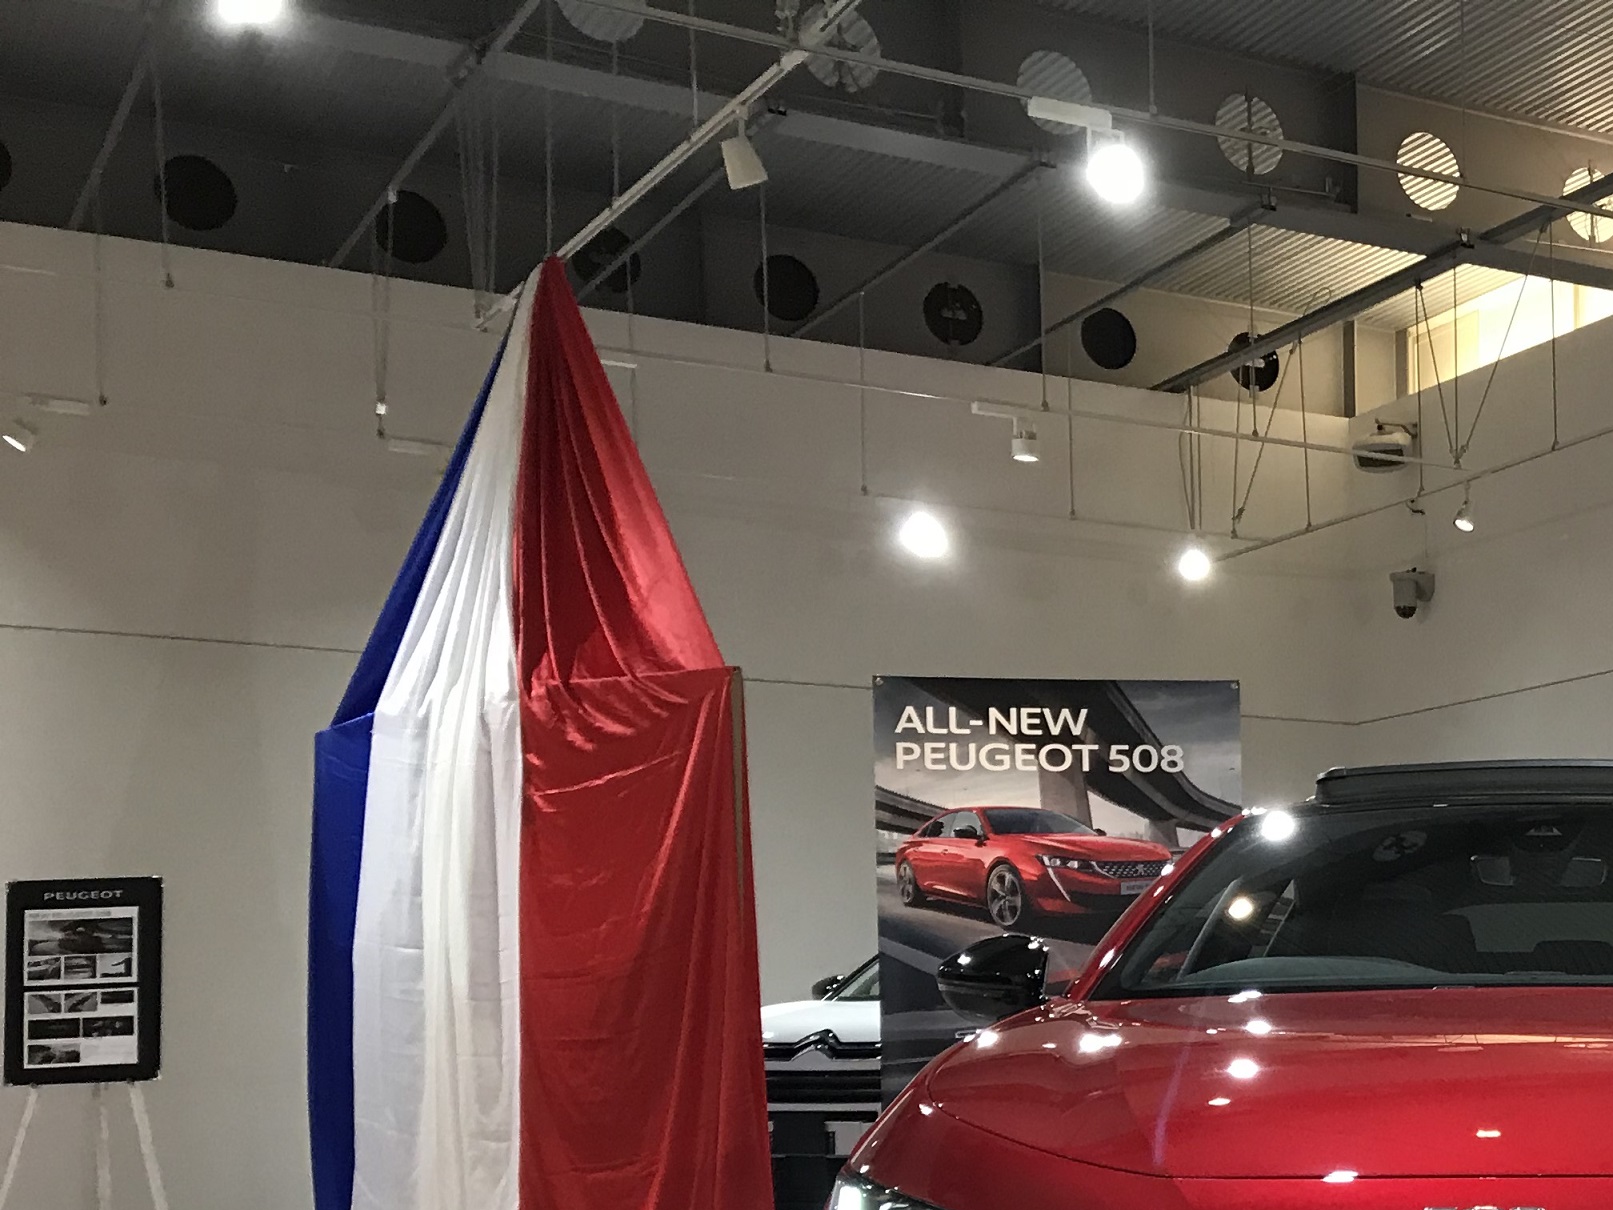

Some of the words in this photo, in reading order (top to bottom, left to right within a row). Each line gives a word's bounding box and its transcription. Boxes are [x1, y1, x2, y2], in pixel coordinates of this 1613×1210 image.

[894, 705, 1088, 736] ALL-NEW
[895, 741, 1099, 772] PEUGEOT
[1108, 744, 1185, 773] 508
[43, 889, 124, 901] PEUGEOT
